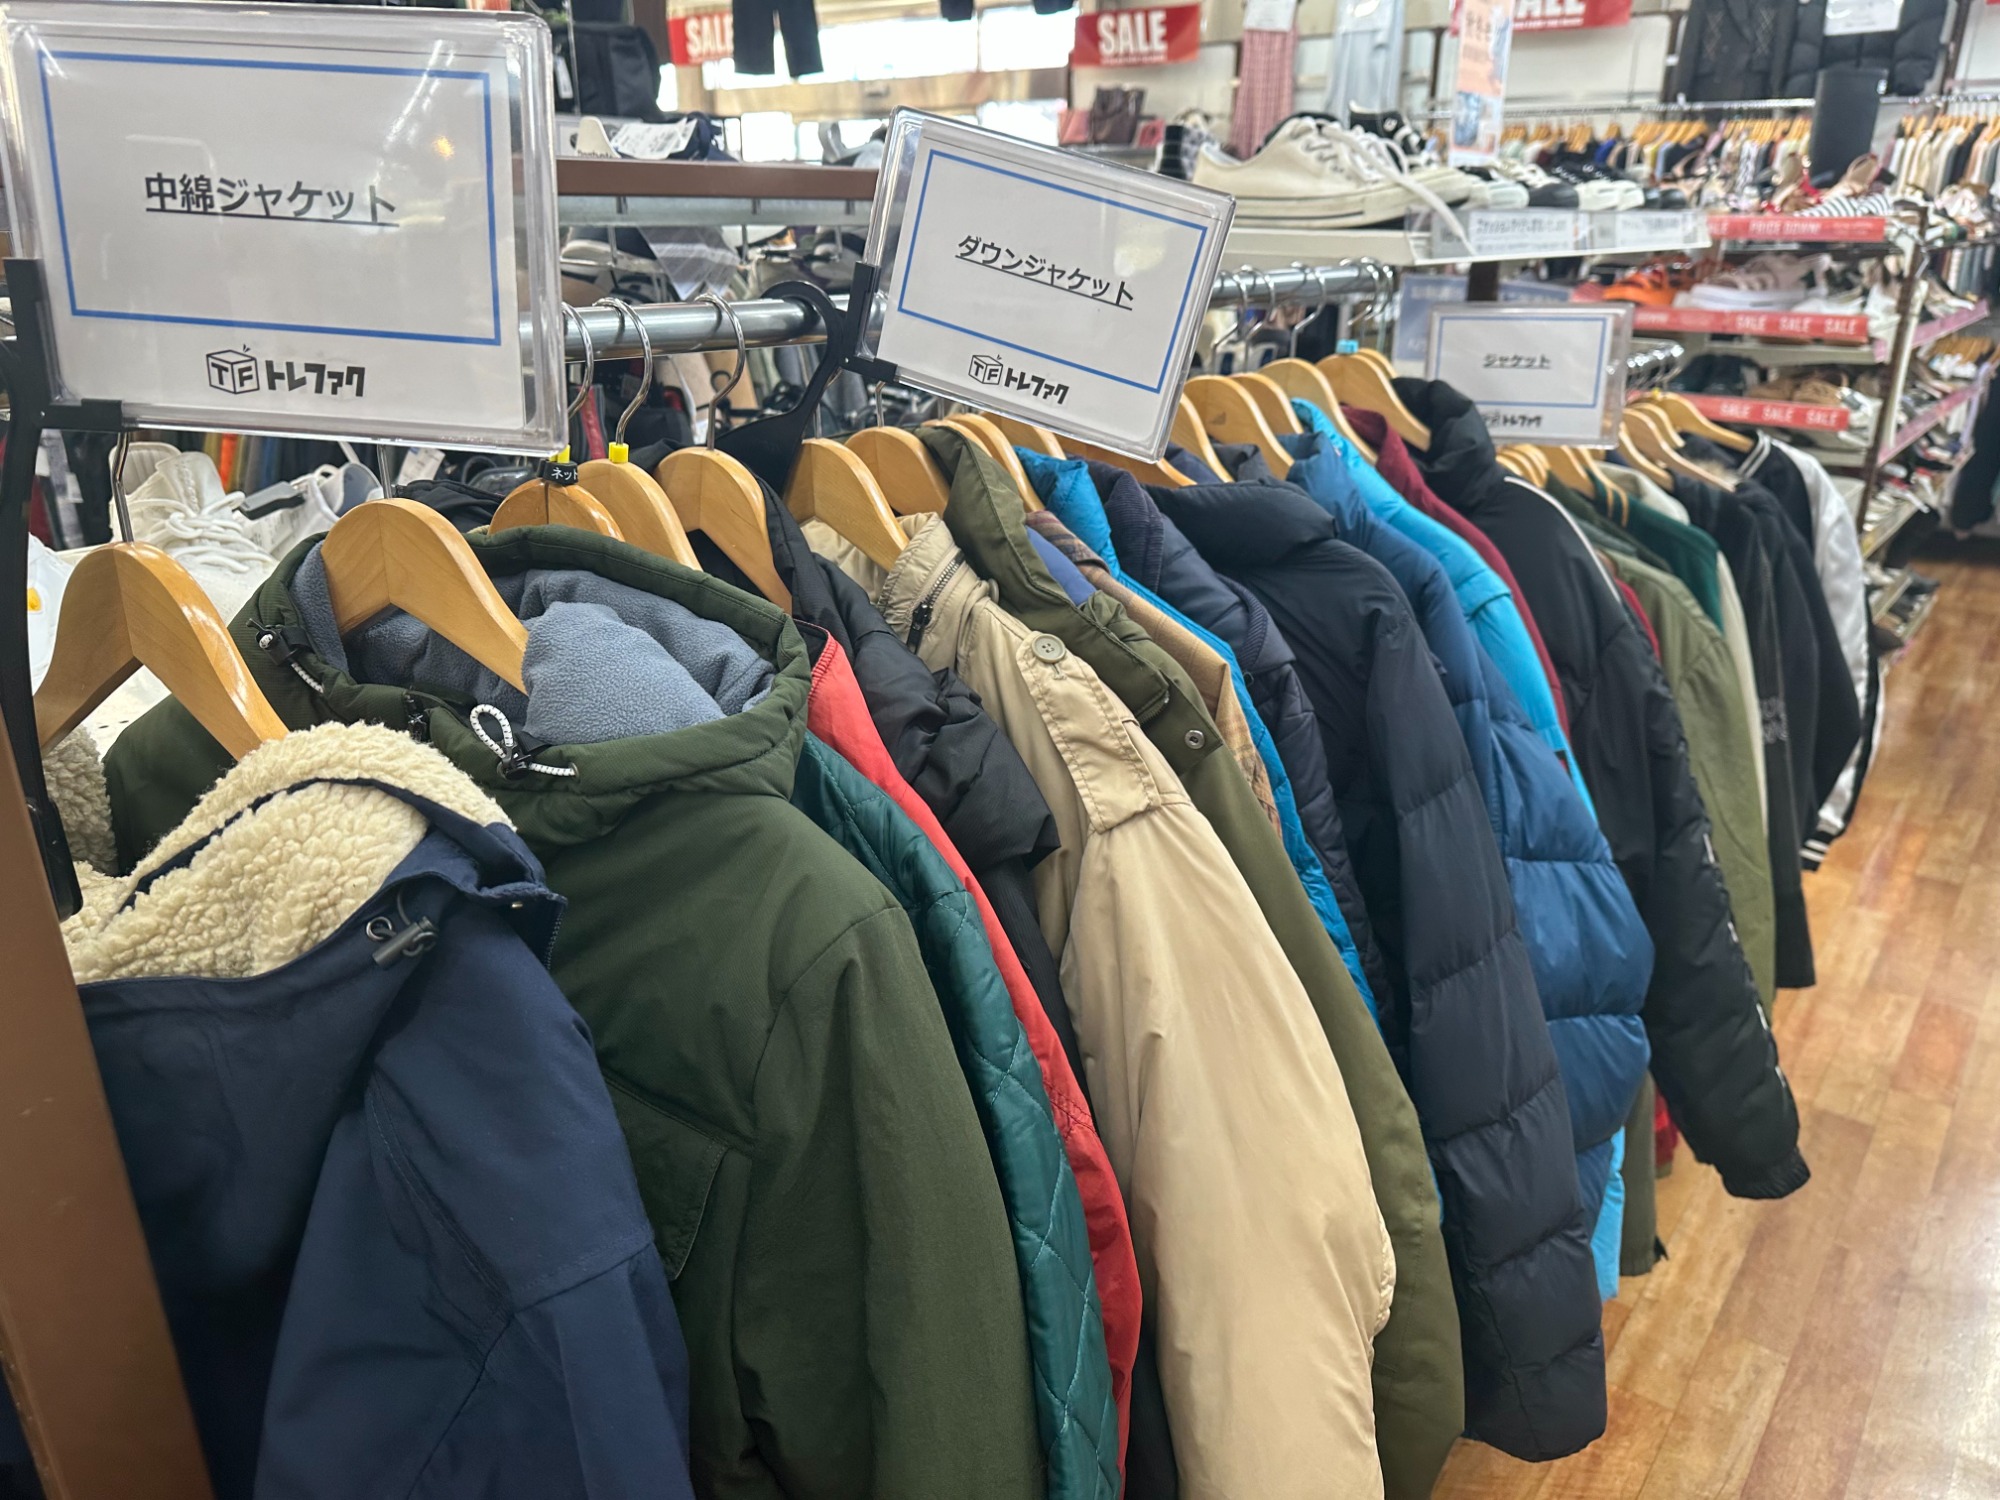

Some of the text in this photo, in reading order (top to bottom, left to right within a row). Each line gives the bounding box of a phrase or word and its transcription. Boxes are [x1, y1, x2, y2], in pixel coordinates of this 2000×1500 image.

[685, 14, 734, 57] SAL
[1097, 8, 1167, 55] SALE
[145, 171, 396, 224] 中綿ジャケット
[957, 235, 1134, 307] ダウンジャケット
[1735, 314, 1767, 331] SALE
[1779, 316, 1812, 333] SALE
[1824, 318, 1858, 335] SALE
[265, 360, 365, 397] トレファク
[1484, 353, 1550, 369] ジャケット
[1004, 367, 1070, 404] トレファク
[1720, 402, 1838, 427] SALE SALE SALE
[551, 467, 578, 481] ネット
